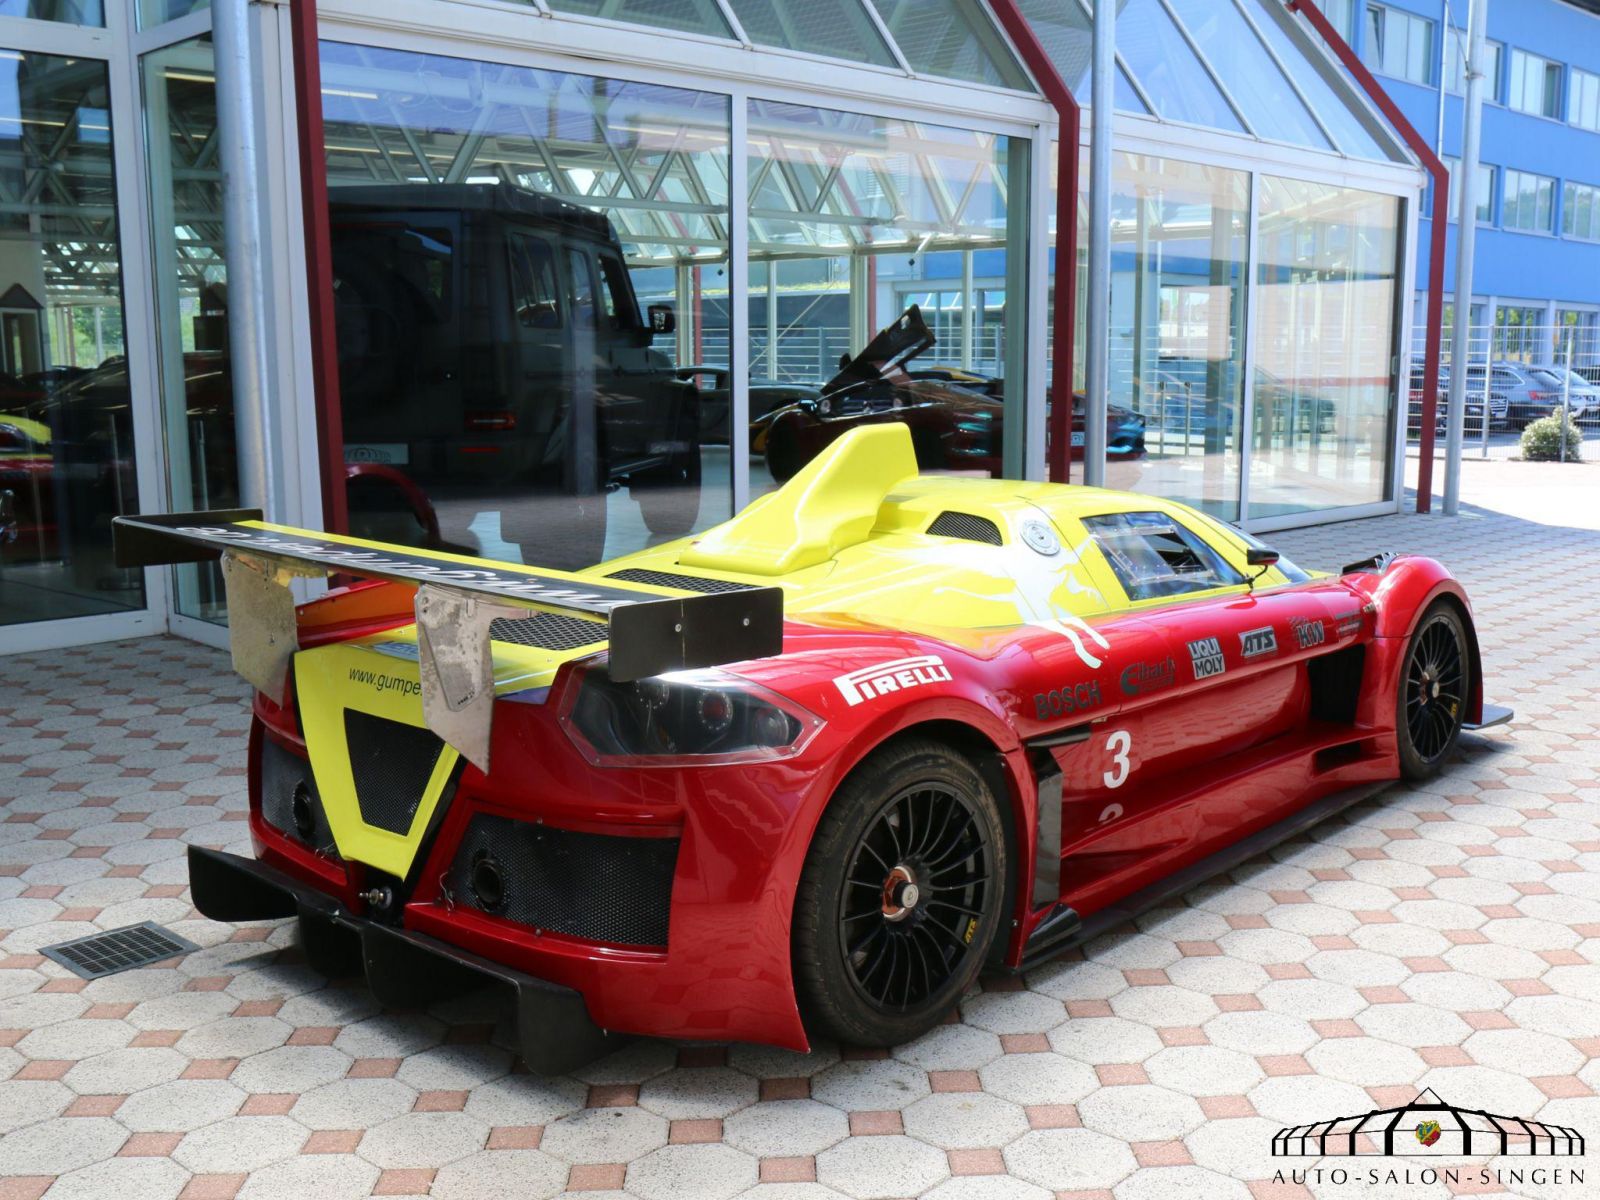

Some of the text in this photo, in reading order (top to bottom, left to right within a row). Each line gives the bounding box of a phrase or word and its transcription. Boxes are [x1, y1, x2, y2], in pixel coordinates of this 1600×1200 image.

[1188, 638, 1220, 660] LIQUI
[1242, 629, 1275, 655] ATS
[349, 667, 423, 697] www.gumpe
[832, 655, 953, 707] PIRELLI
[1195, 656, 1223, 678] MOLY
[1033, 680, 1102, 720] BOSCH
[1104, 730, 1131, 789] 3
